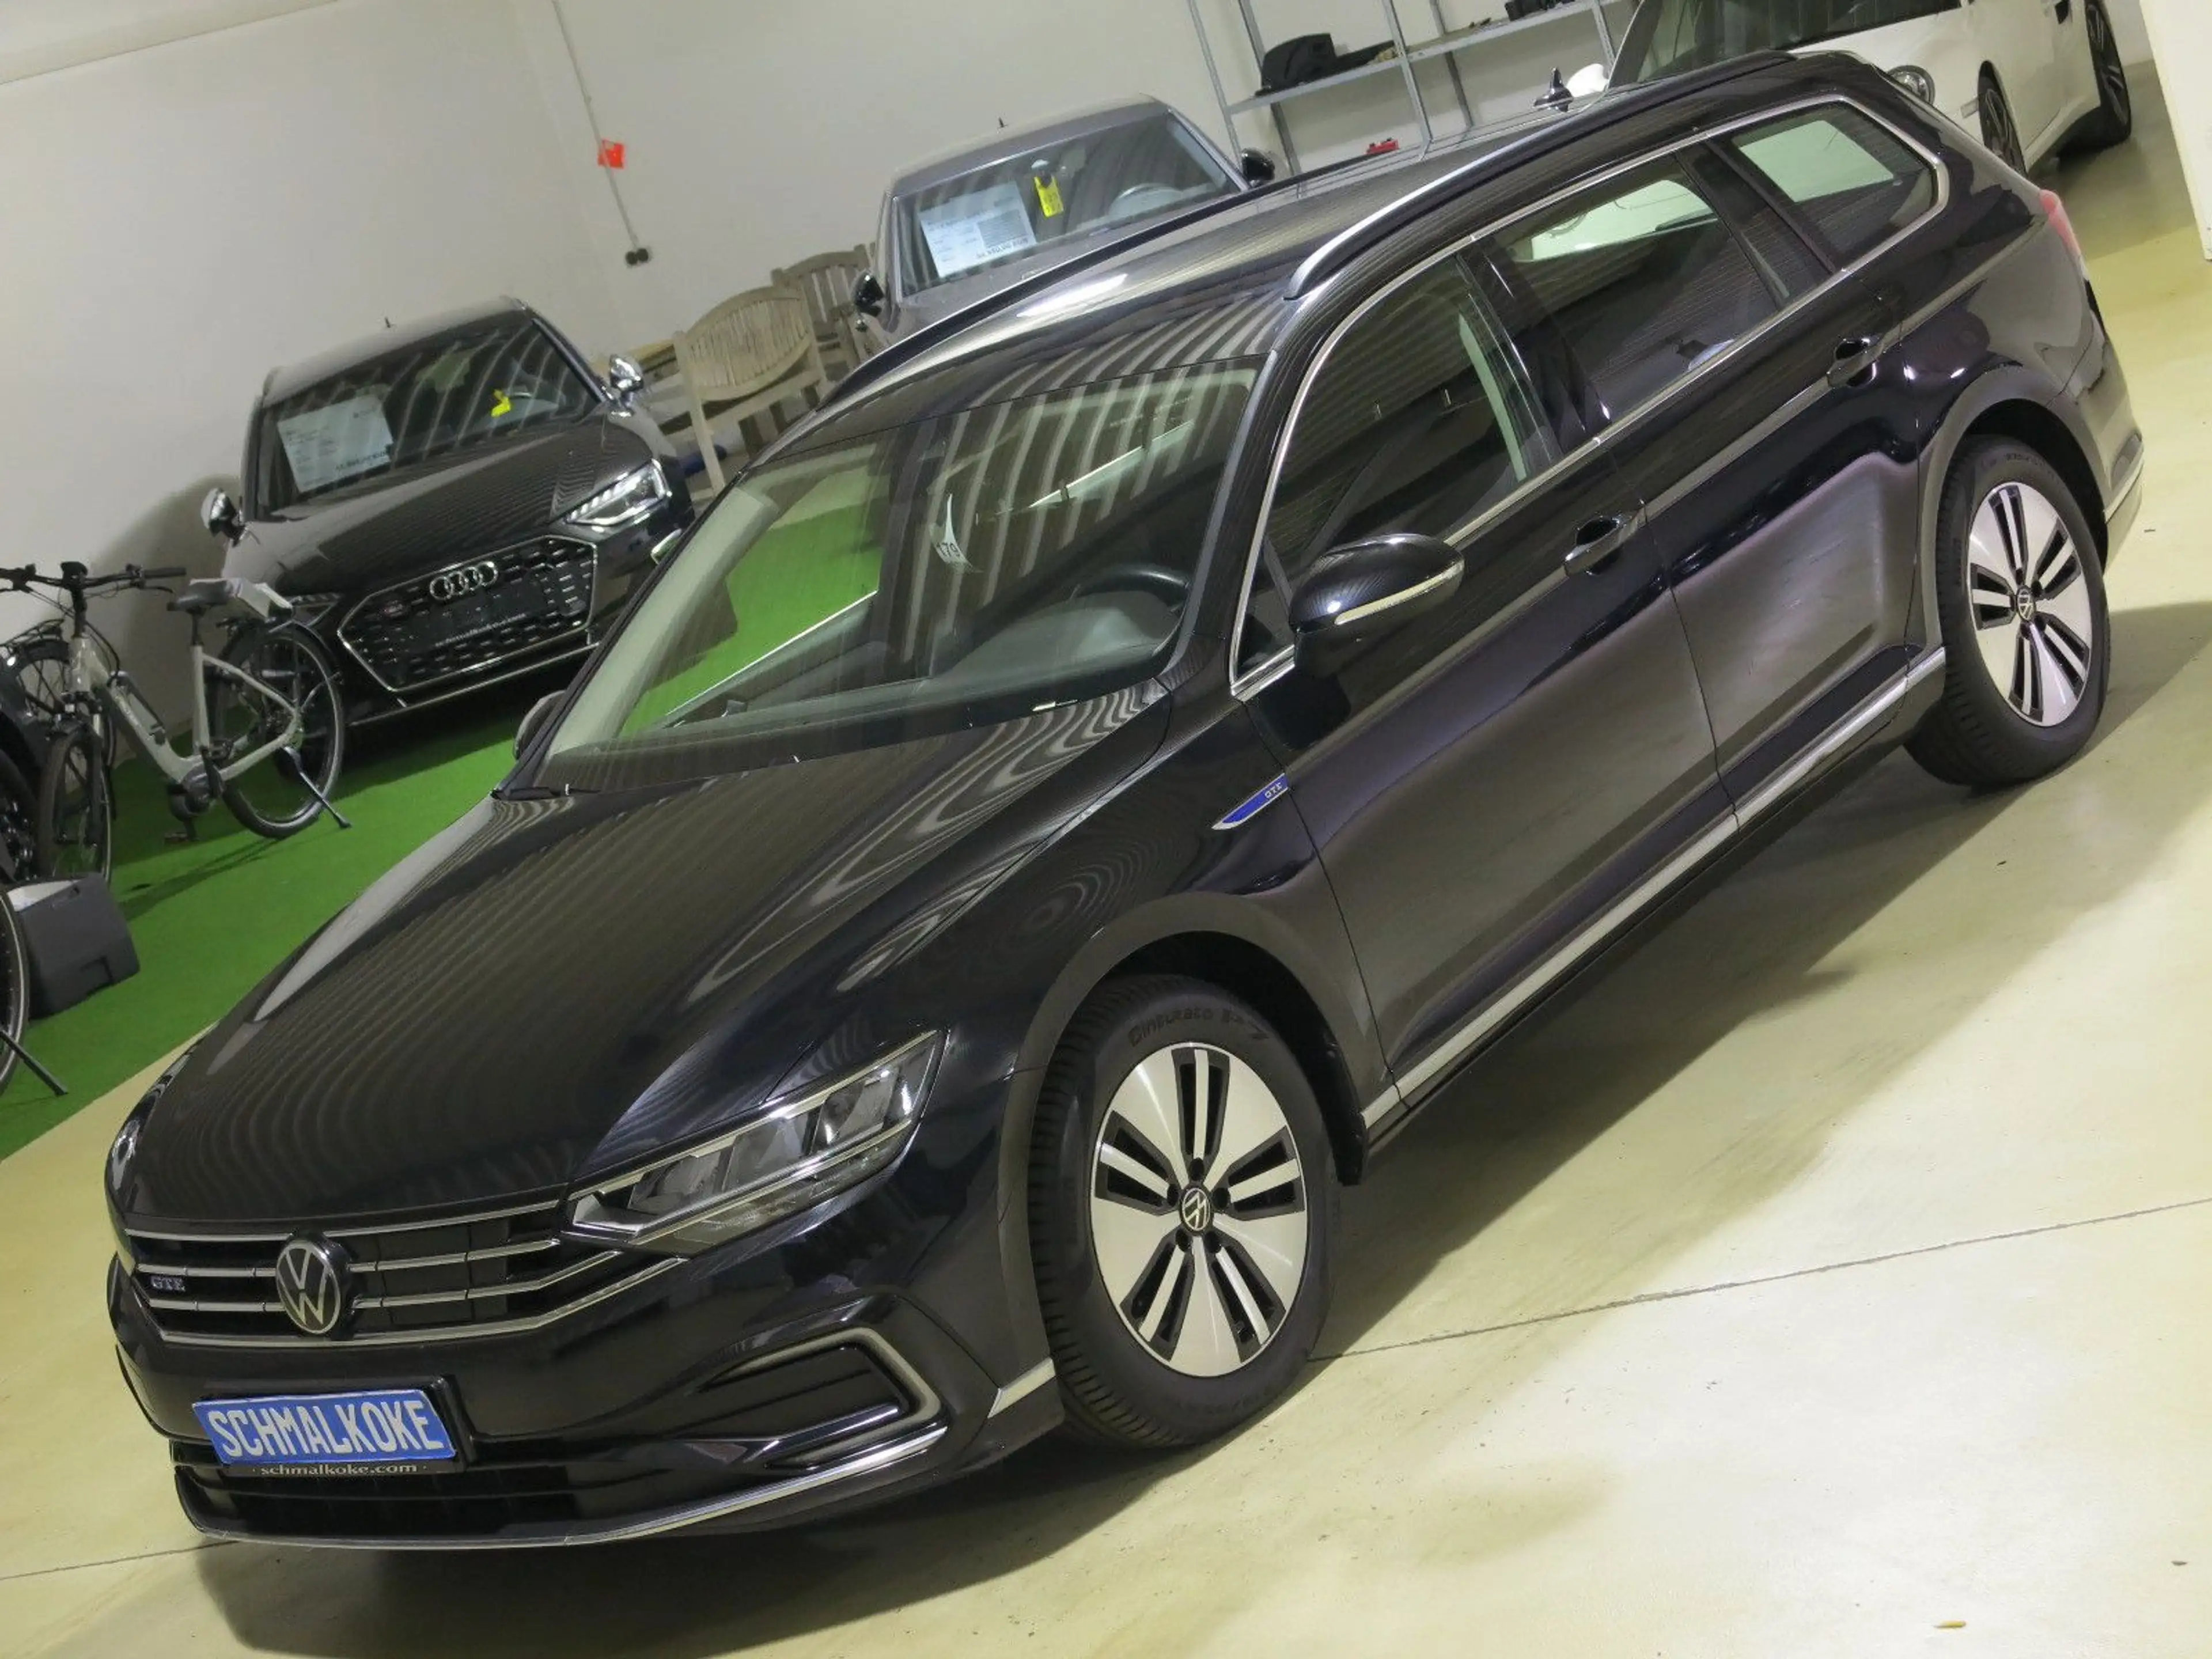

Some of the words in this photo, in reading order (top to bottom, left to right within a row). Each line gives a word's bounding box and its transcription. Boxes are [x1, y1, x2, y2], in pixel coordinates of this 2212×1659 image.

[150, 1275, 186, 1292] GTE
[209, 1400, 444, 1458] SCHMALKOKE
[261, 1463, 418, 1476] schmalkoke.com
